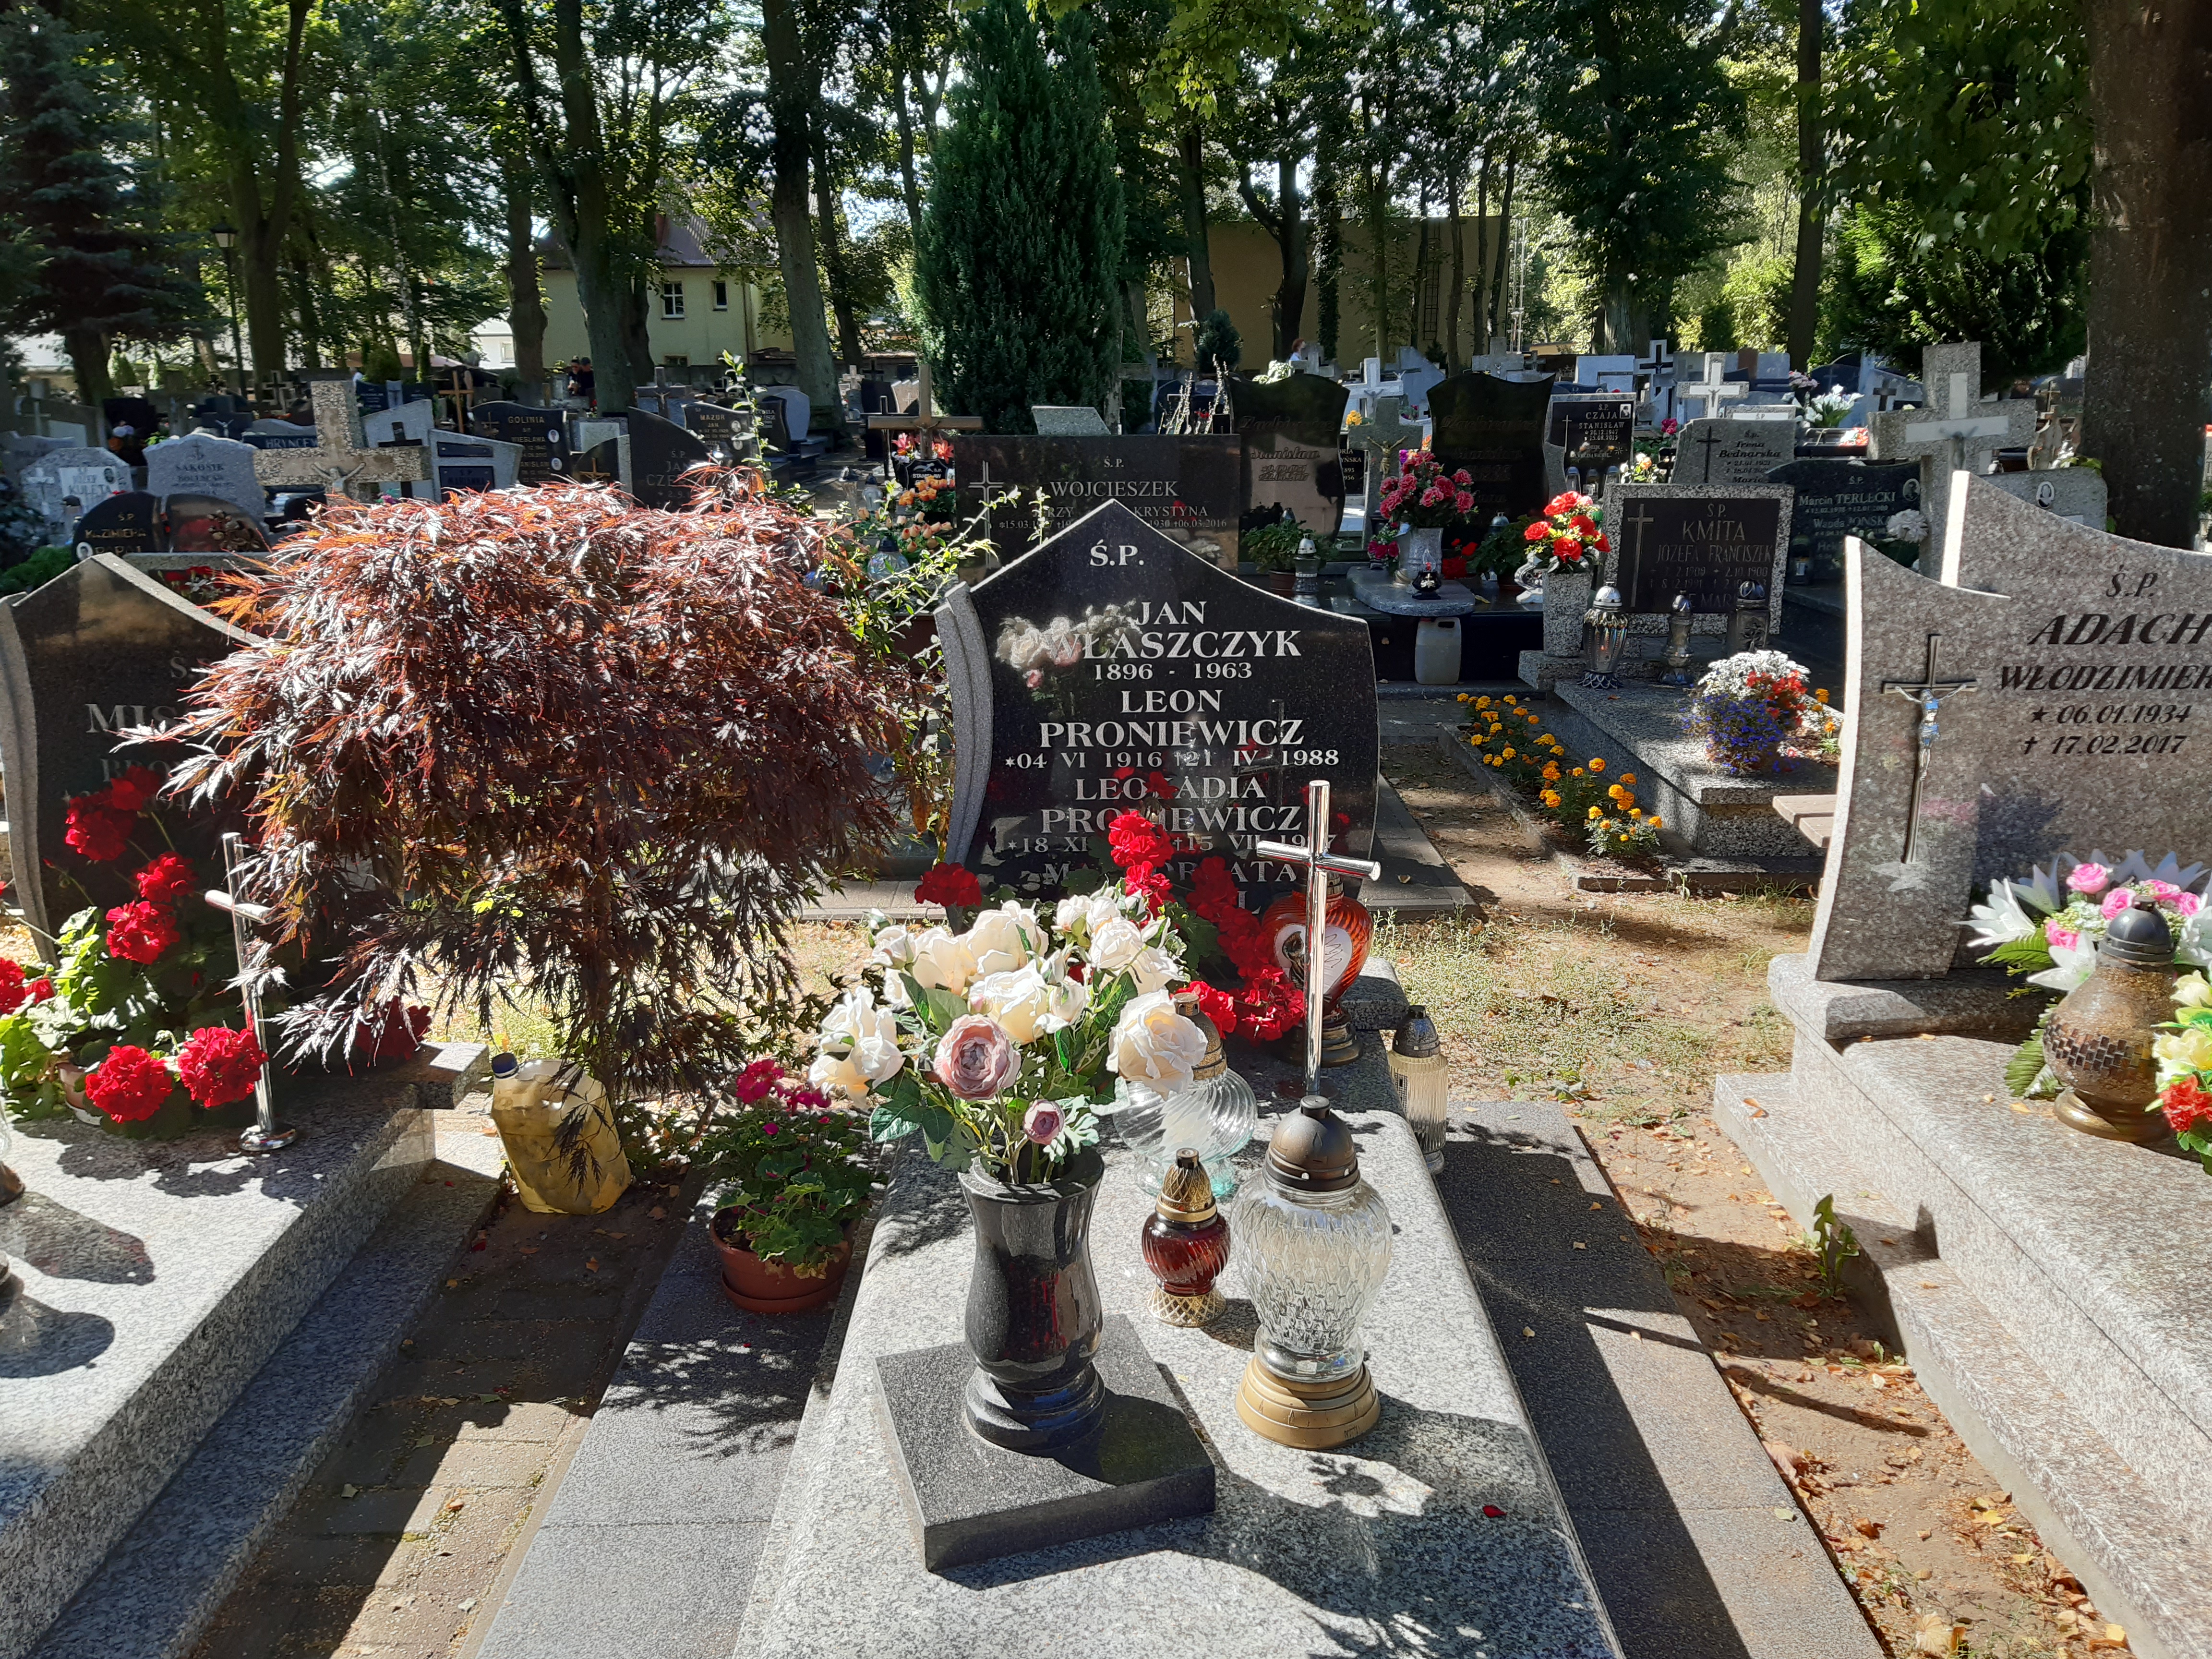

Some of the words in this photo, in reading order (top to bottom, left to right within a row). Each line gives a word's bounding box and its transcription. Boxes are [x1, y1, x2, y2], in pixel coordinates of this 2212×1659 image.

[1586, 411, 1618, 420] CZAJA
[1050, 481, 1179, 497] WOJCIESZEK
[1032, 506, 1074, 517] JRZY
[1134, 506, 1209, 517] KRYSTYNA
[1682, 520, 1746, 543] KMITA
[1090, 539, 1145, 567] Ś.P.
[1708, 545, 1773, 563] FRANCISZEK
[2105, 564, 2158, 598] Ś.P.
[1136, 601, 1207, 625] JAN
[2028, 613, 2212, 644] ADACH
[1047, 630, 1302, 660] WŁASZCZYK
[1094, 663, 1154, 681] 1896
[1194, 662, 1252, 680] 1963
[2001, 665, 2212, 690] WŁODZIMIER
[1121, 689, 1223, 714] LEON
[2057, 705, 2191, 724] 06.01.1934
[1040, 720, 1304, 748] PRONIEWICZ
[2052, 735, 2187, 755] 17.02.2017
[1061, 754, 1088, 768] VI
[1105, 754, 1163, 768] 1916
[1233, 751, 1260, 767] IV
[1282, 750, 1339, 767] 1988
[1076, 777, 1265, 801] LEOADIA
[1042, 806, 1302, 834] PROIEWICZ
[1023, 837, 1048, 853] 18
[1281, 834, 1337, 849] 197
